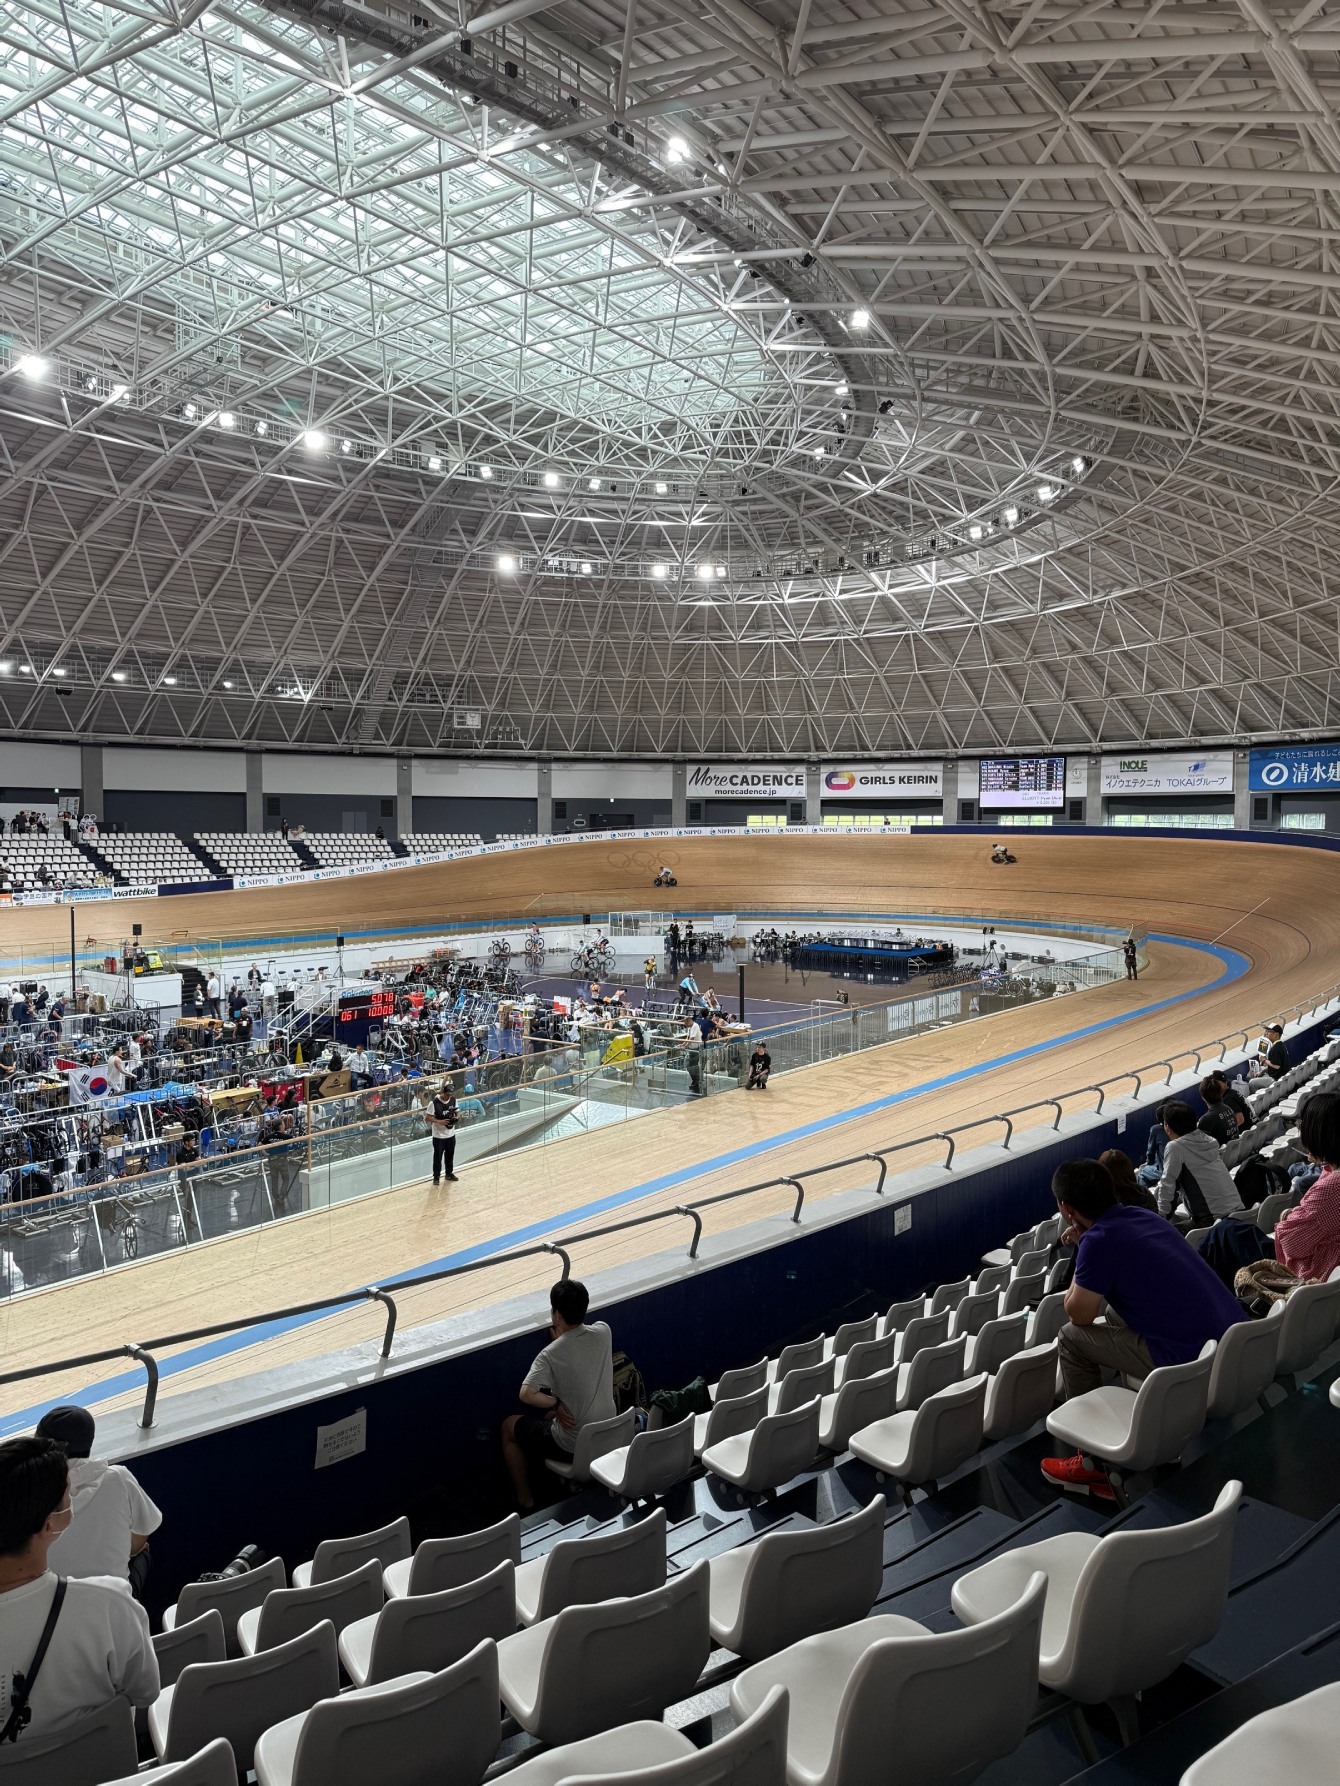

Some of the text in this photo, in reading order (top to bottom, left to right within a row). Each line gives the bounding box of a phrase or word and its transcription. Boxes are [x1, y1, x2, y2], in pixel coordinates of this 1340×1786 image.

[1293, 760, 1340, 783] 清水建
[859, 775, 938, 785] GIRLS KEIRIN
[1106, 778, 1160, 788] イノウエテクニカ
[1166, 776, 1227, 787] TOKAIグループ
[714, 788, 777, 796] morecadence.jp
[552, 836, 570, 844] NIPPO
[488, 844, 505, 852] NIPPO
[389, 860, 407, 868] NIPPO
[321, 870, 340, 878] NIPPO
[356, 865, 374, 874] NIPPO
[247, 878, 268, 886] NIPPO
[285, 874, 305, 883] NIPPO
[113, 888, 156, 898] wattbike
